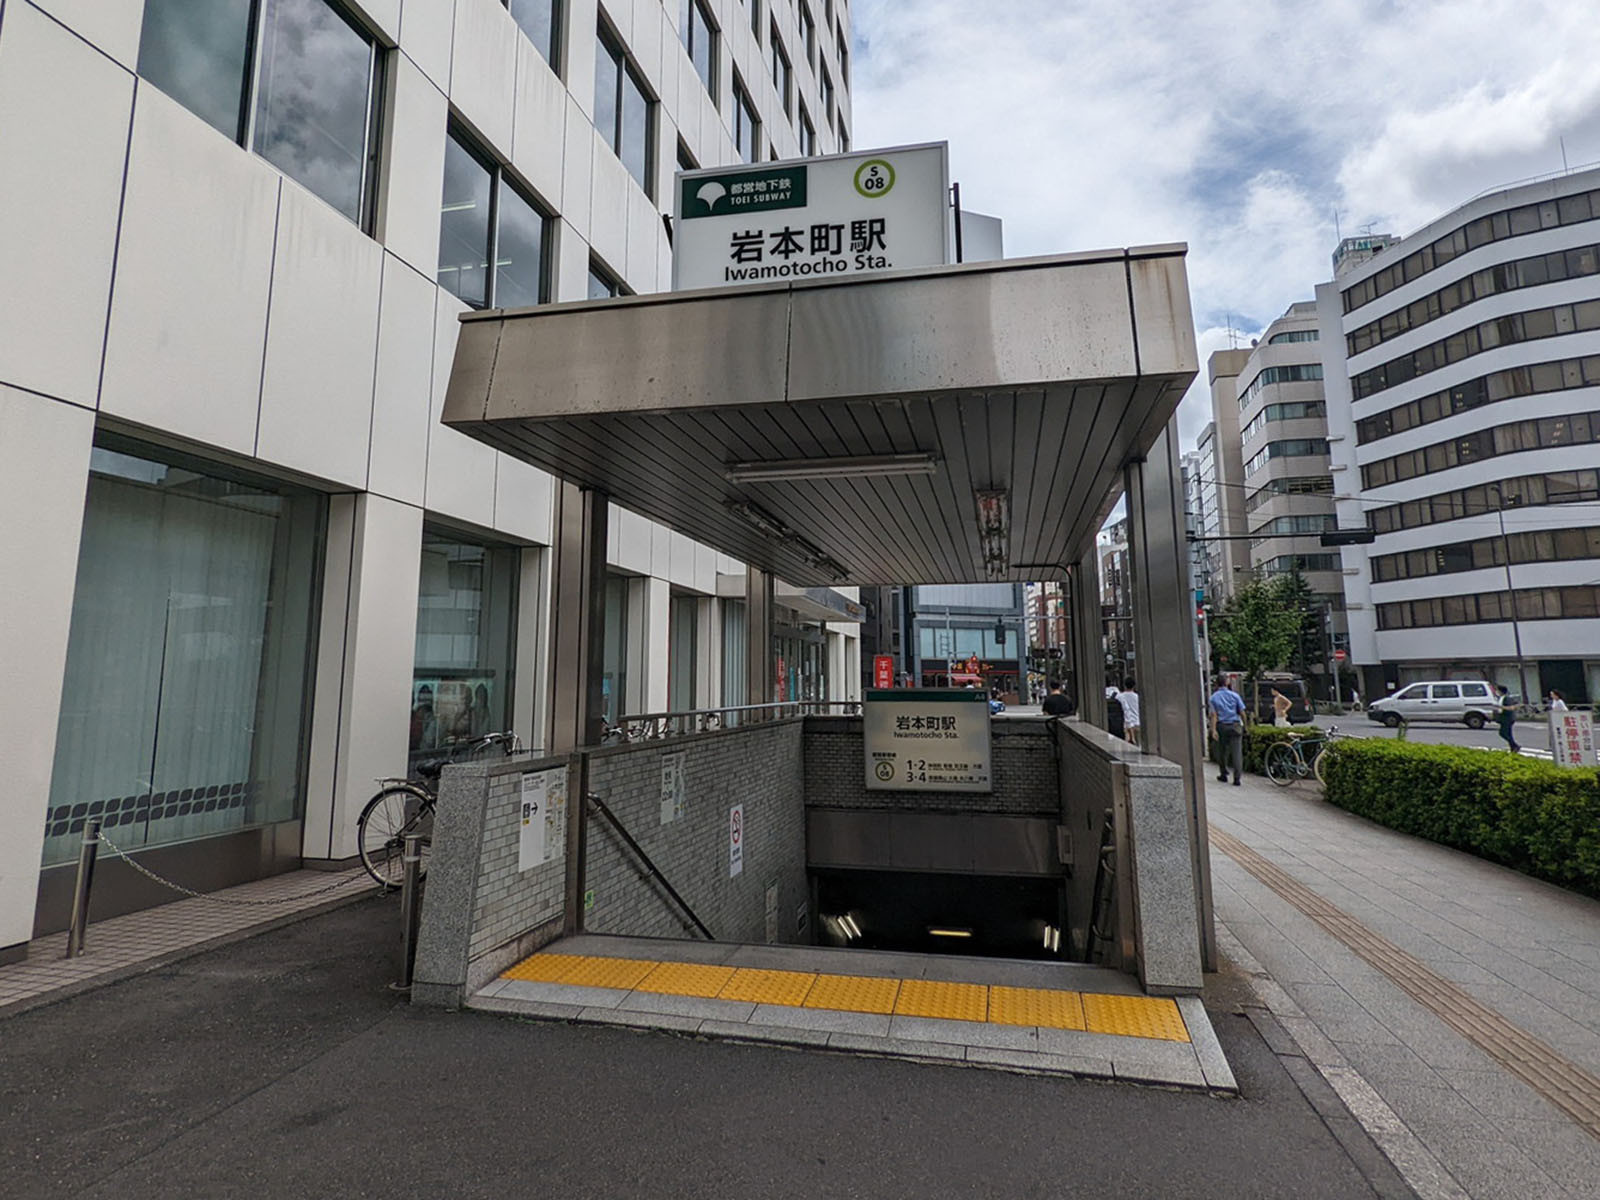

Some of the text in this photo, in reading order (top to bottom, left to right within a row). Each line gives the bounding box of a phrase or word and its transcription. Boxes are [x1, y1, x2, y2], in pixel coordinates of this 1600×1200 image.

[870, 166, 879, 177] S
[731, 178, 792, 195] 都営地下鉄
[864, 177, 885, 190] 08
[731, 191, 792, 205] TOEI SUBWAY
[730, 218, 887, 264] 岩本町駅
[725, 254, 893, 281] Iwamotocho Sta.
[896, 716, 956, 730] 岩本町駅
[894, 731, 960, 739] Iwamotocho Sta.
